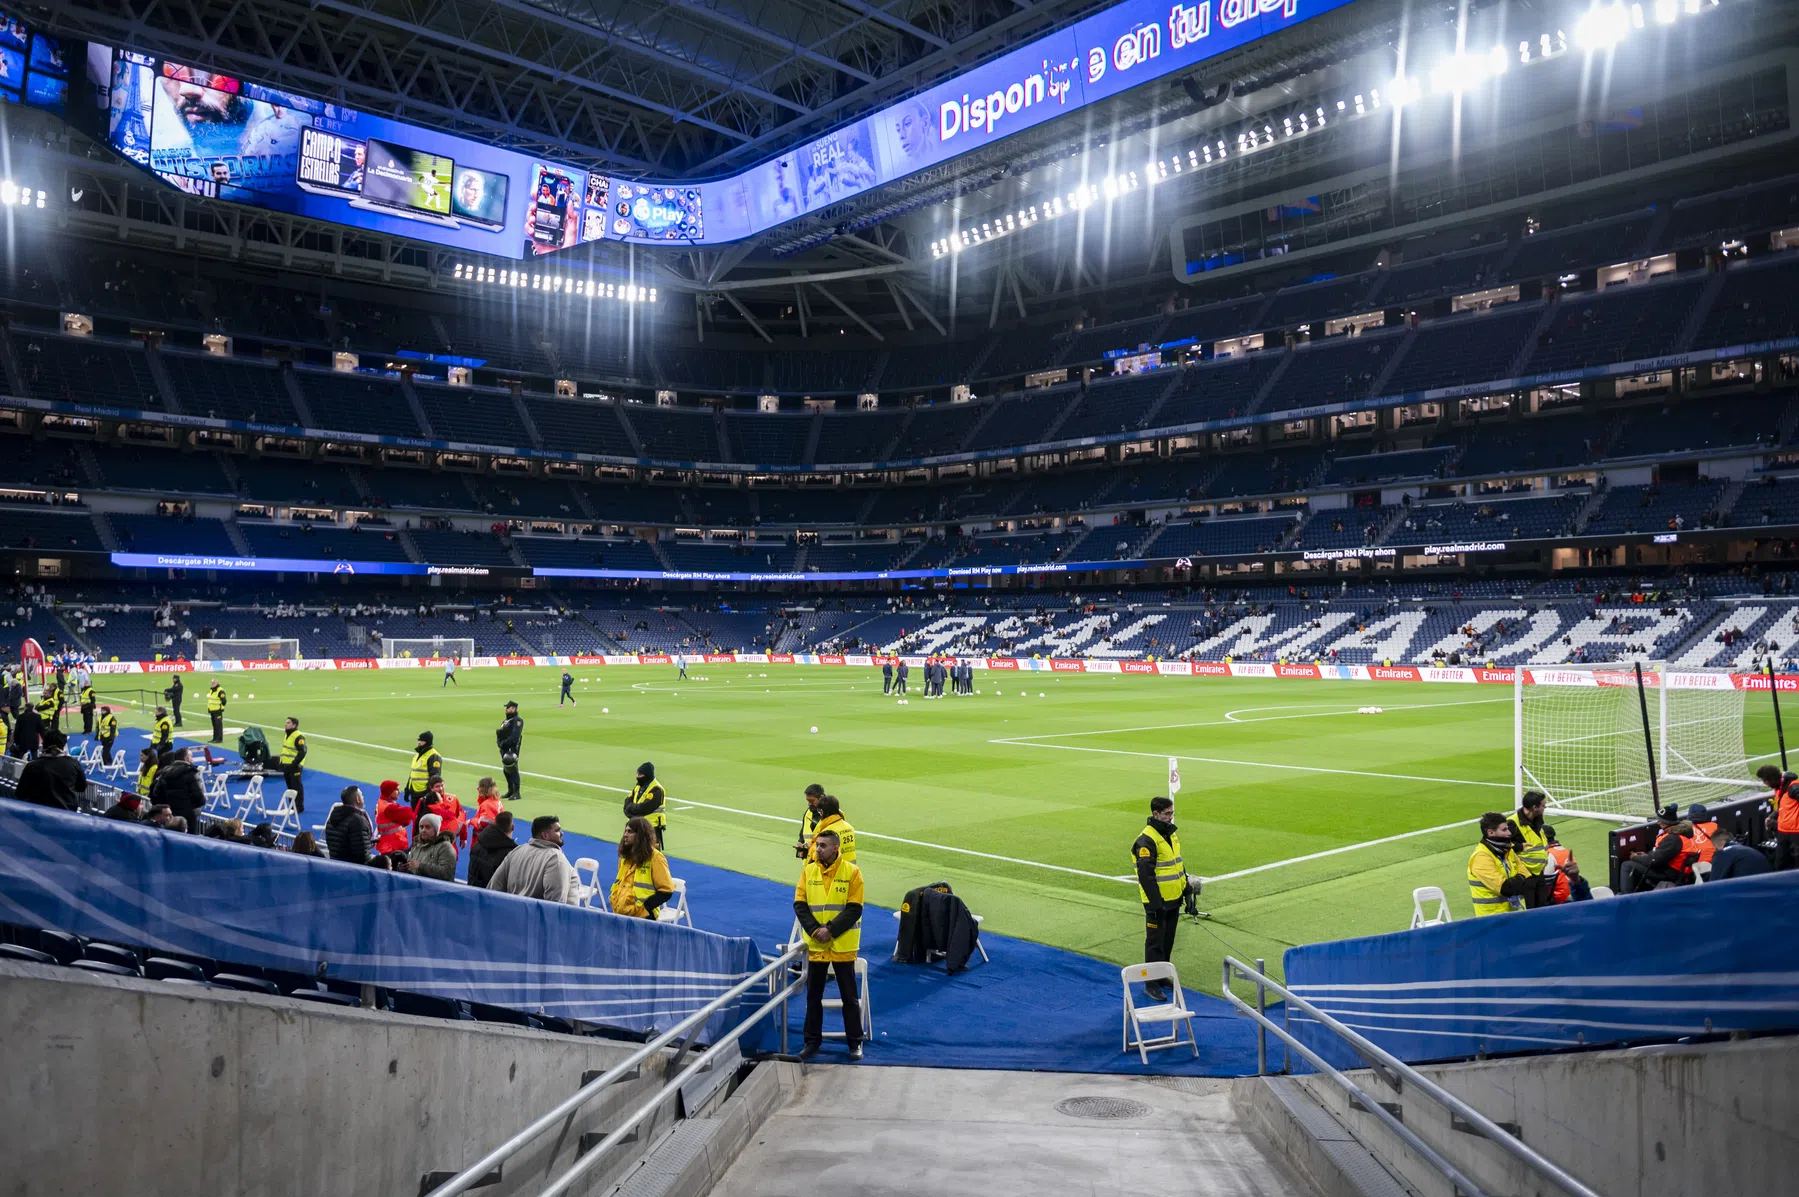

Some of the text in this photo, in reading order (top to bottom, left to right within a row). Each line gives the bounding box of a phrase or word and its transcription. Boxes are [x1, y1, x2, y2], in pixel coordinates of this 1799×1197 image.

[1169, 2, 1211, 49] tu
[812, 142, 845, 168] REAL
[300, 156, 340, 185] ESTRELLAS
[652, 207, 684, 225] Play
[1634, 356, 1688, 371] Real Madrid
[1556, 370, 1583, 380] Madrid
[1464, 385, 1490, 394] Madrid
[1344, 550, 1357, 558] RM
[1358, 548, 1374, 559] Play
[1375, 547, 1396, 556] ahora
[1424, 543, 1506, 555] play.realmadrid.com
[204, 558, 216, 566] RM
[218, 559, 233, 567] Play
[428, 566, 489, 575] play.realmadrid.com
[1017, 564, 1066, 574] play.realmadrid.com
[503, 658, 530, 666] Emirates
[644, 656, 668, 664] Emirates
[822, 656, 842, 664] Emirates
[992, 660, 1014, 668] Emirates
[149, 663, 186, 672] Emirates
[250, 662, 284, 670] Emirates
[1054, 662, 1080, 670] Emirates
[1125, 664, 1152, 672] Emirates
[1195, 665, 1225, 674] Emirates
[1280, 668, 1314, 676] Emirates
[1376, 668, 1412, 678] Emirates
[1430, 671, 1464, 680] FLY BETTER
[1482, 672, 1524, 681] Emirats
[1674, 676, 1717, 686] FLY BETTER
